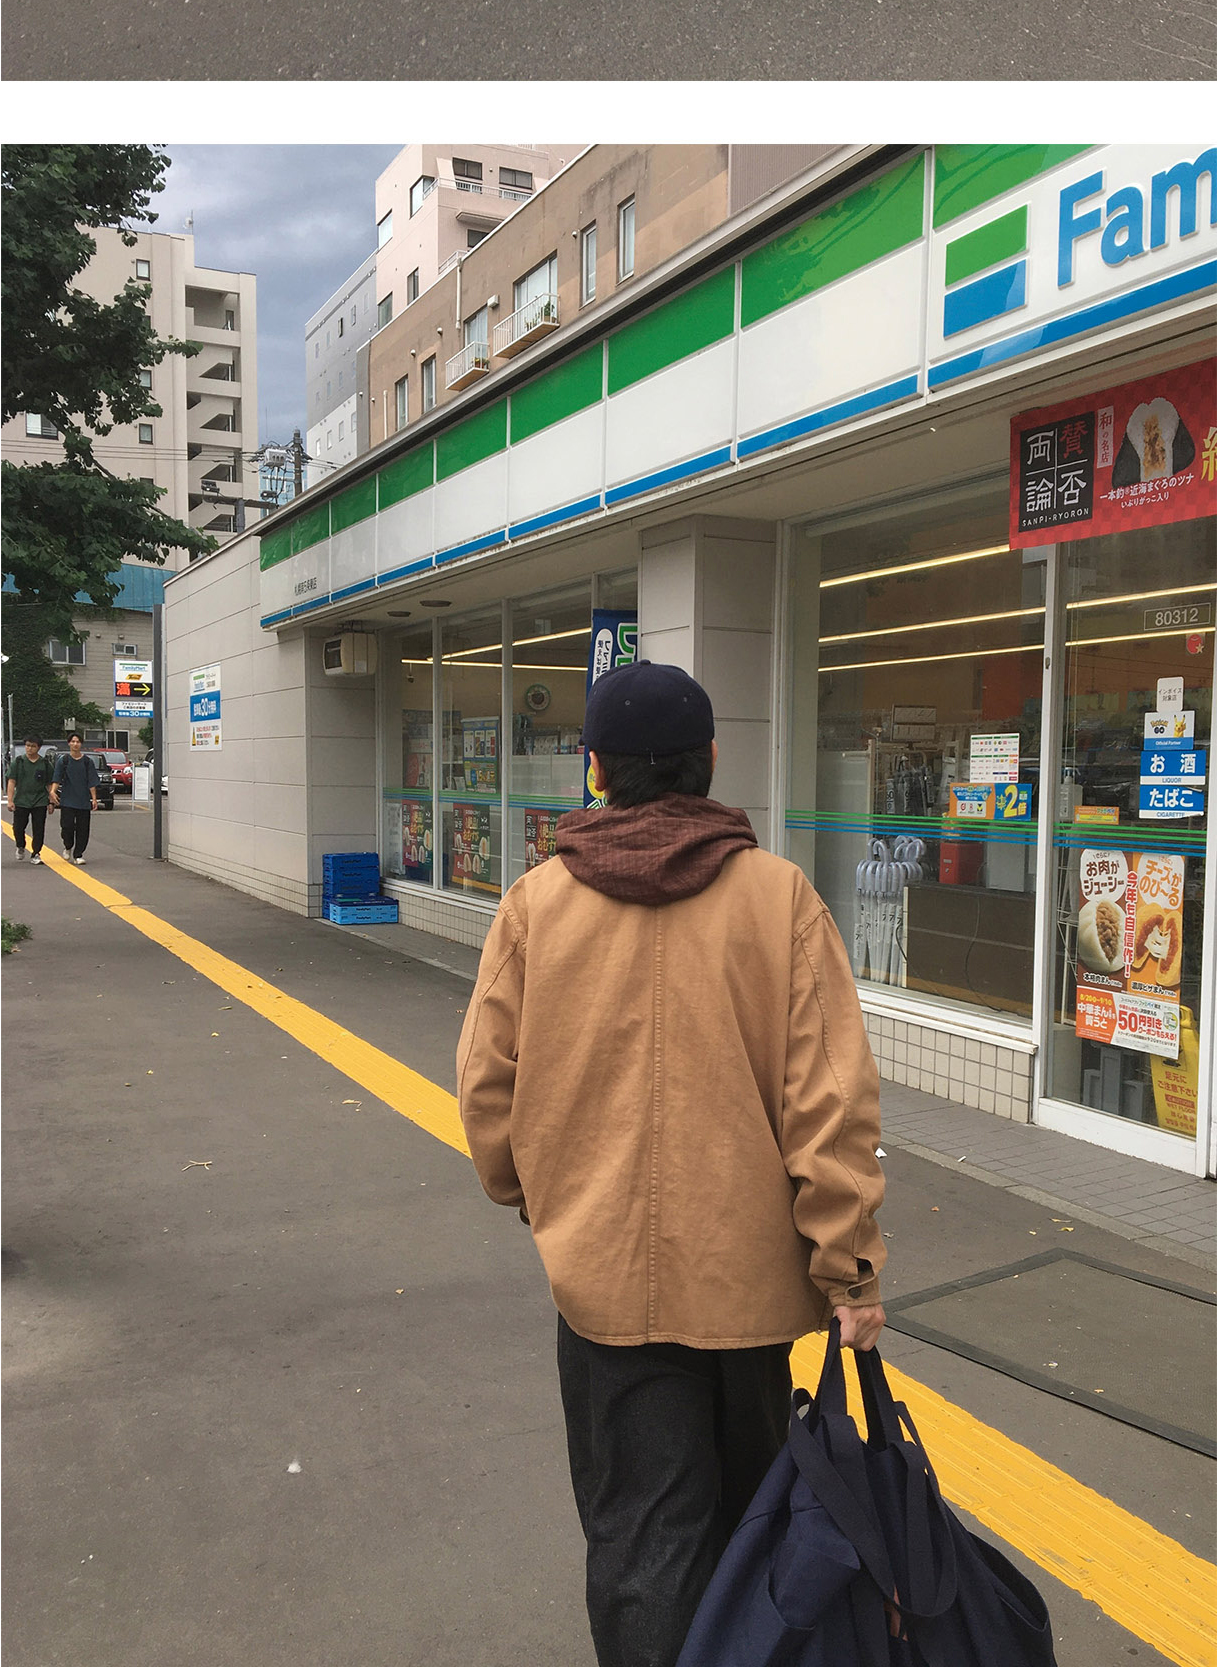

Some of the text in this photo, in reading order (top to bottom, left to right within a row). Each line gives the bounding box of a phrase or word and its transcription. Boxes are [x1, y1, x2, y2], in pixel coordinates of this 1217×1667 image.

[1057, 147, 1217, 287] Fam
[1098, 412, 1112, 464] 和の名店
[1120, 491, 1170, 509] いぶりがっこ入り
[1022, 508, 1090, 527] SANPI-RYORON
[1155, 608, 1199, 627] 80312
[1158, 687, 1182, 695] インボイス
[1149, 788, 1194, 808] たばこ
[1086, 860, 1120, 877] お肉が
[1145, 860, 1182, 887] チーズが
[1083, 876, 1125, 897] ジューシー
[1085, 1014, 1107, 1029] 買うと
[1118, 1010, 1163, 1033] 50円引き
[1164, 1071, 1187, 1084] 足元に
[1157, 1080, 1198, 1098] ご注意下さい
